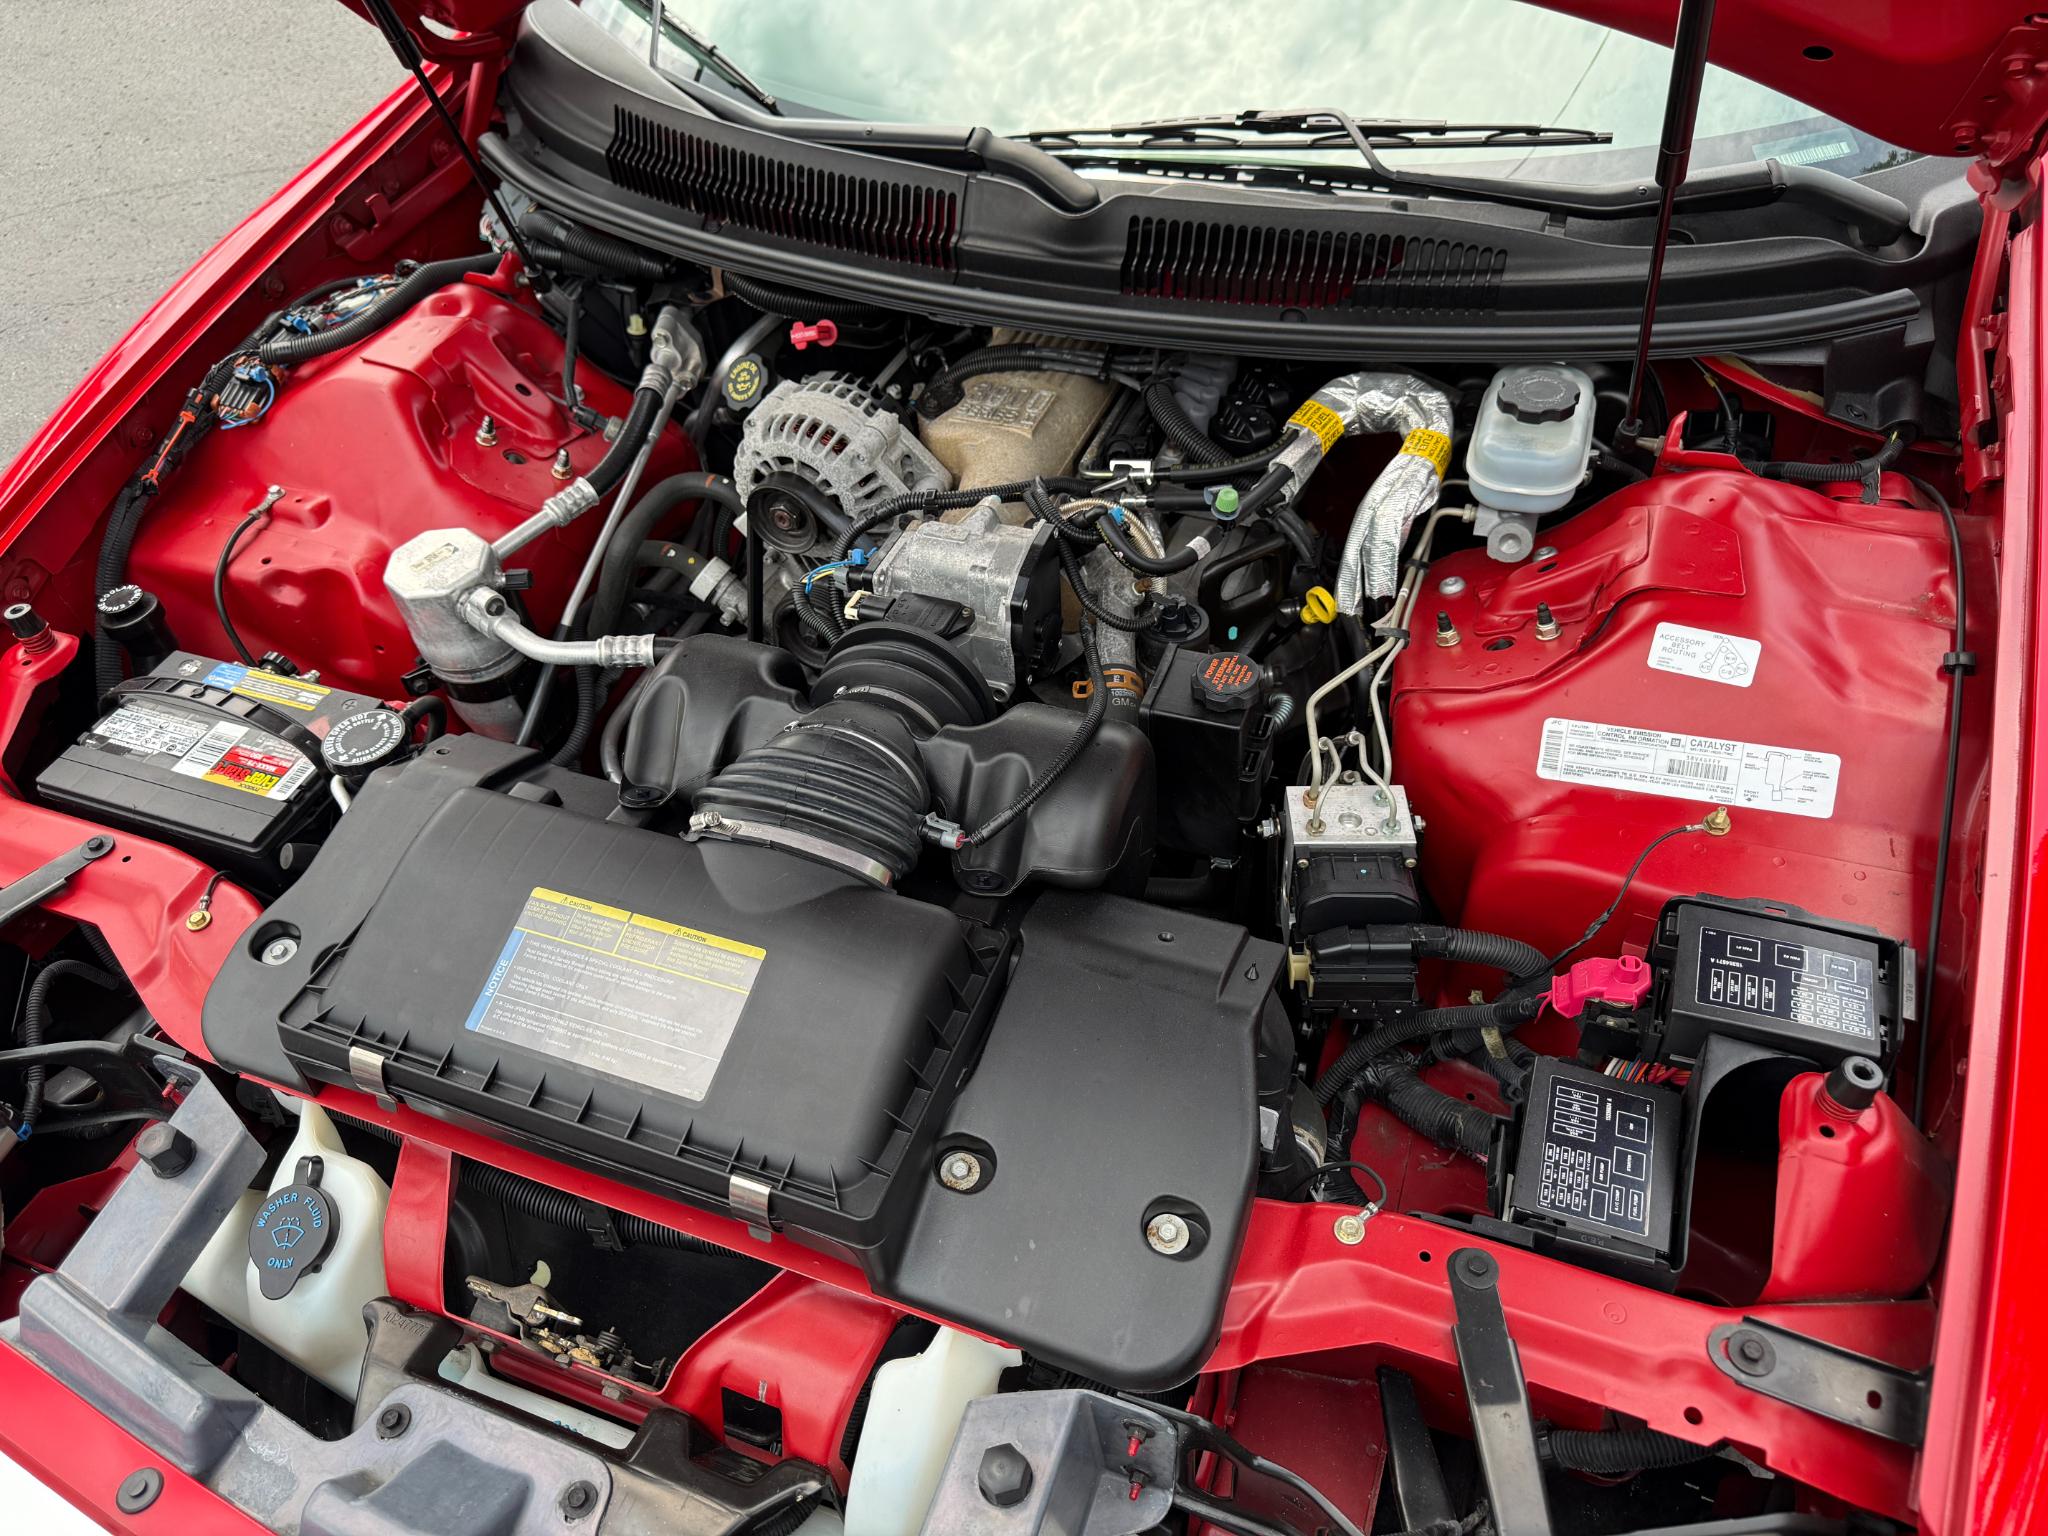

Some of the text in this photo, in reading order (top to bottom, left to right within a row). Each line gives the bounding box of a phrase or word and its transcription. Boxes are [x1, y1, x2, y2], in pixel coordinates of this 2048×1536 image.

[1310, 412, 1331, 431] FUEL
[1418, 434, 1434, 452] FUEL
[1659, 633, 1705, 647] ACCESSORY
[1671, 641, 1689, 650] BELT
[1661, 646, 1696, 658] ROUTING
[1204, 658, 1219, 679] POWER
[350, 711, 370, 723] HOT
[1597, 731, 1626, 739] CONTROL
[1628, 734, 1669, 745] INFORMATION
[1633, 730, 1661, 738] EMISSION
[1689, 739, 1737, 752] CATALYST
[568, 899, 592, 910] CAUTION
[681, 931, 707, 942] CAUTION
[484, 958, 509, 997] NOTICE
[257, 1192, 323, 1229] WASHER FLUID
[266, 1256, 295, 1270] ONLY
